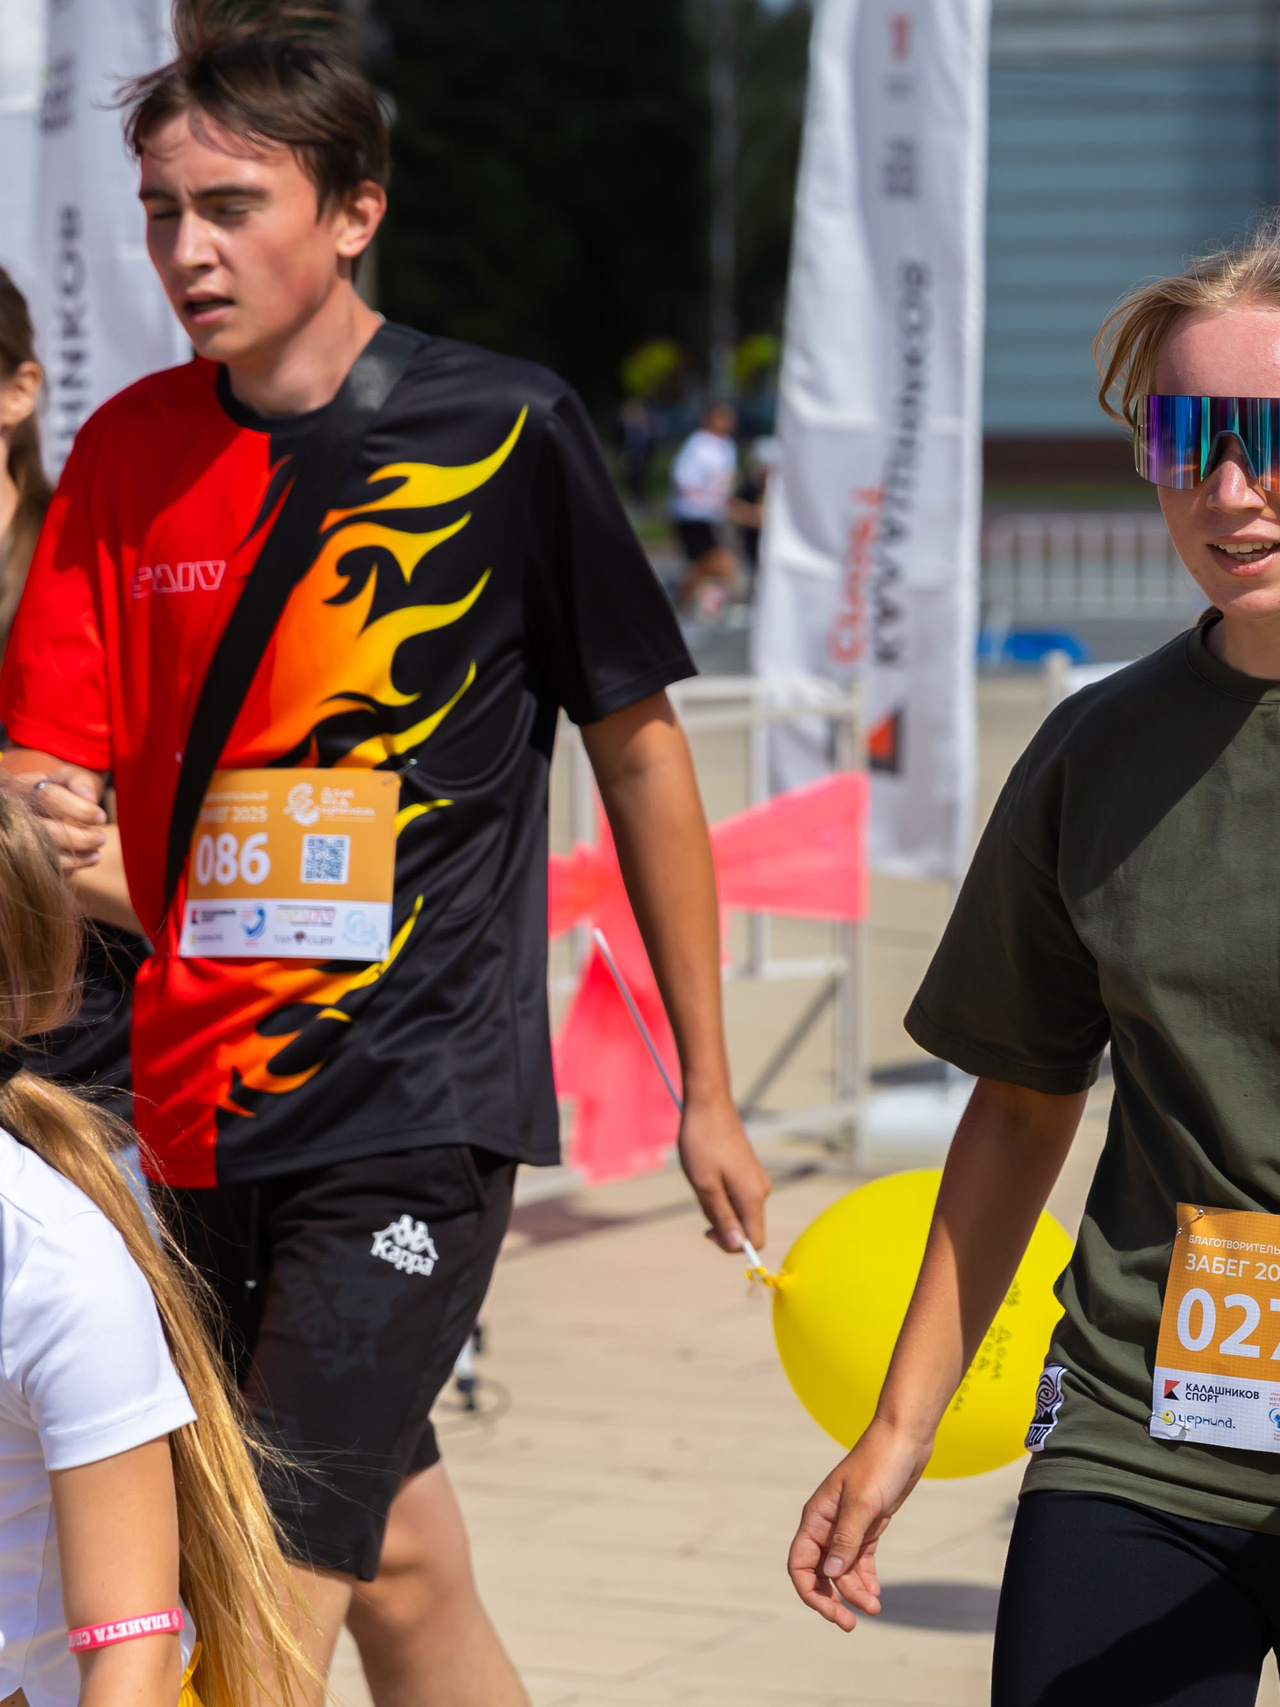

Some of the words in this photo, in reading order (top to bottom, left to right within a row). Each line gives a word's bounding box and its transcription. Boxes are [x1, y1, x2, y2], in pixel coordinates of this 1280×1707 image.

[195, 832, 271, 886] 086
[370, 1237, 435, 1277] Kappa
[1185, 1252, 1250, 1278] ЗАБЕГ
[1185, 1382, 1260, 1400] КАЛАШНИКОВ
[1185, 1392, 1219, 1404] СПОРТ
[93, 1613, 171, 1643] ПЛАНЕТА
